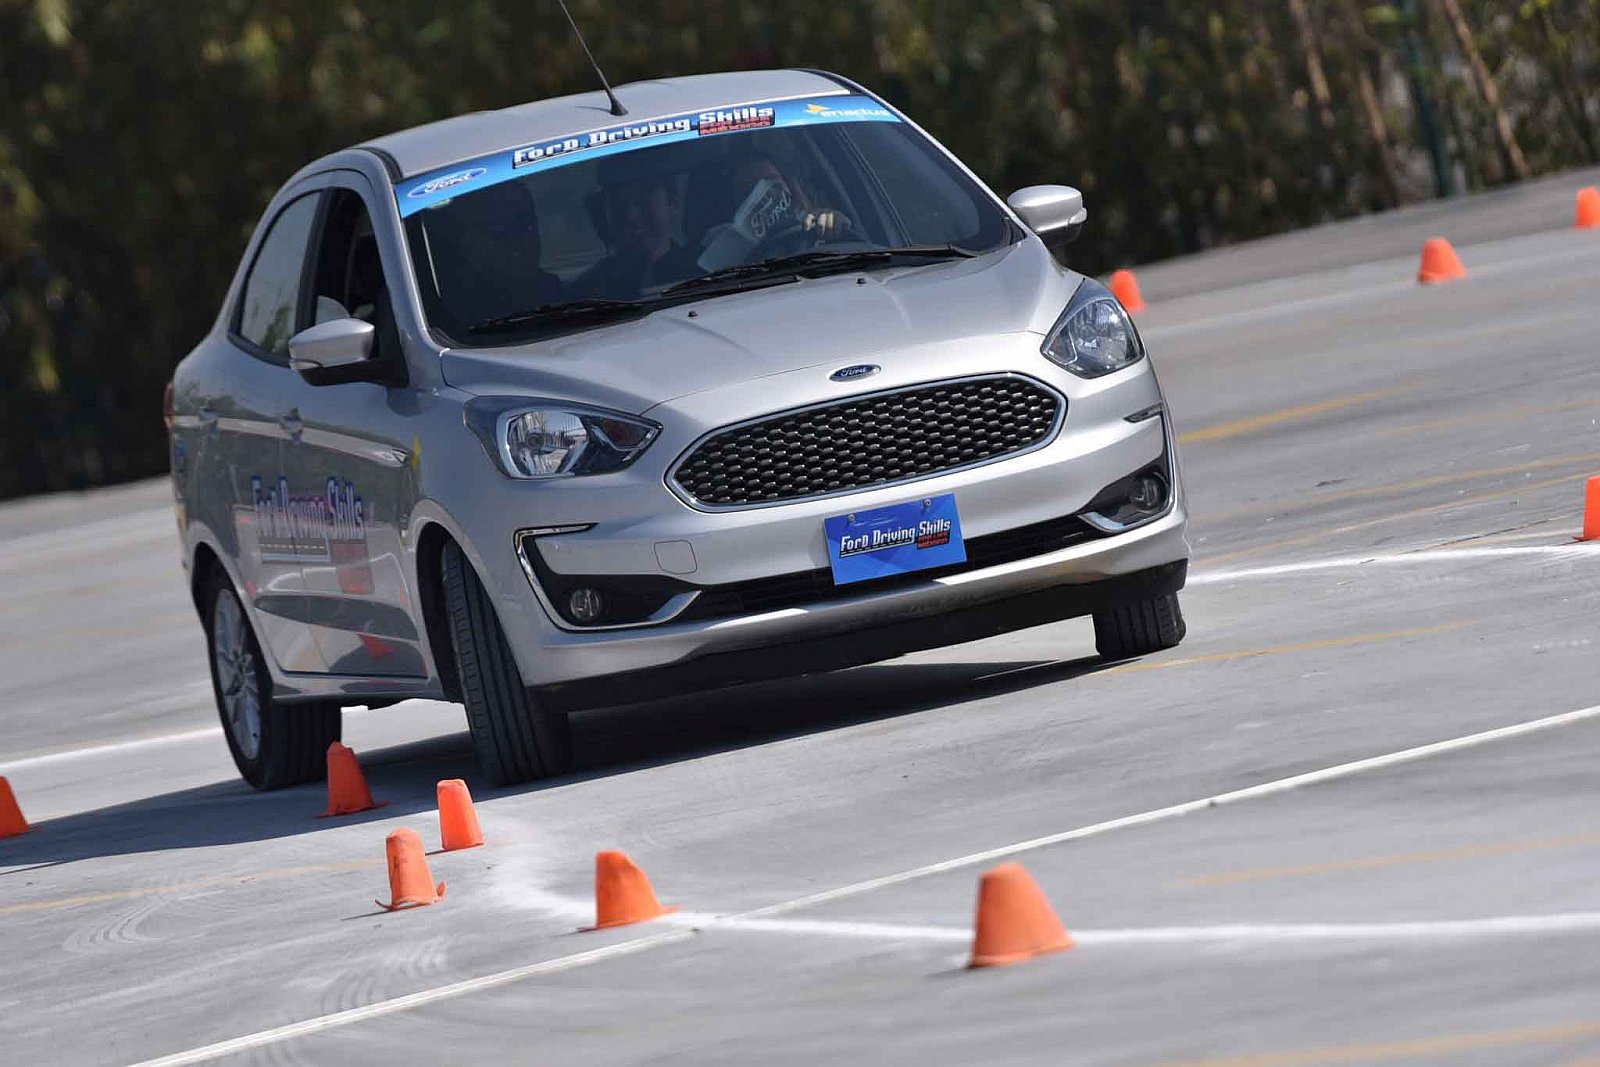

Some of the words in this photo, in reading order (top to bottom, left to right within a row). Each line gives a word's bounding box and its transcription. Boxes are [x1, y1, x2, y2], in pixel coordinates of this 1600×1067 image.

[587, 118, 692, 146] Driving
[698, 105, 774, 125] Skills
[422, 170, 474, 195] Ford
[751, 188, 793, 238] Ford
[872, 525, 916, 546] Driving
[918, 518, 951, 537] Skills
